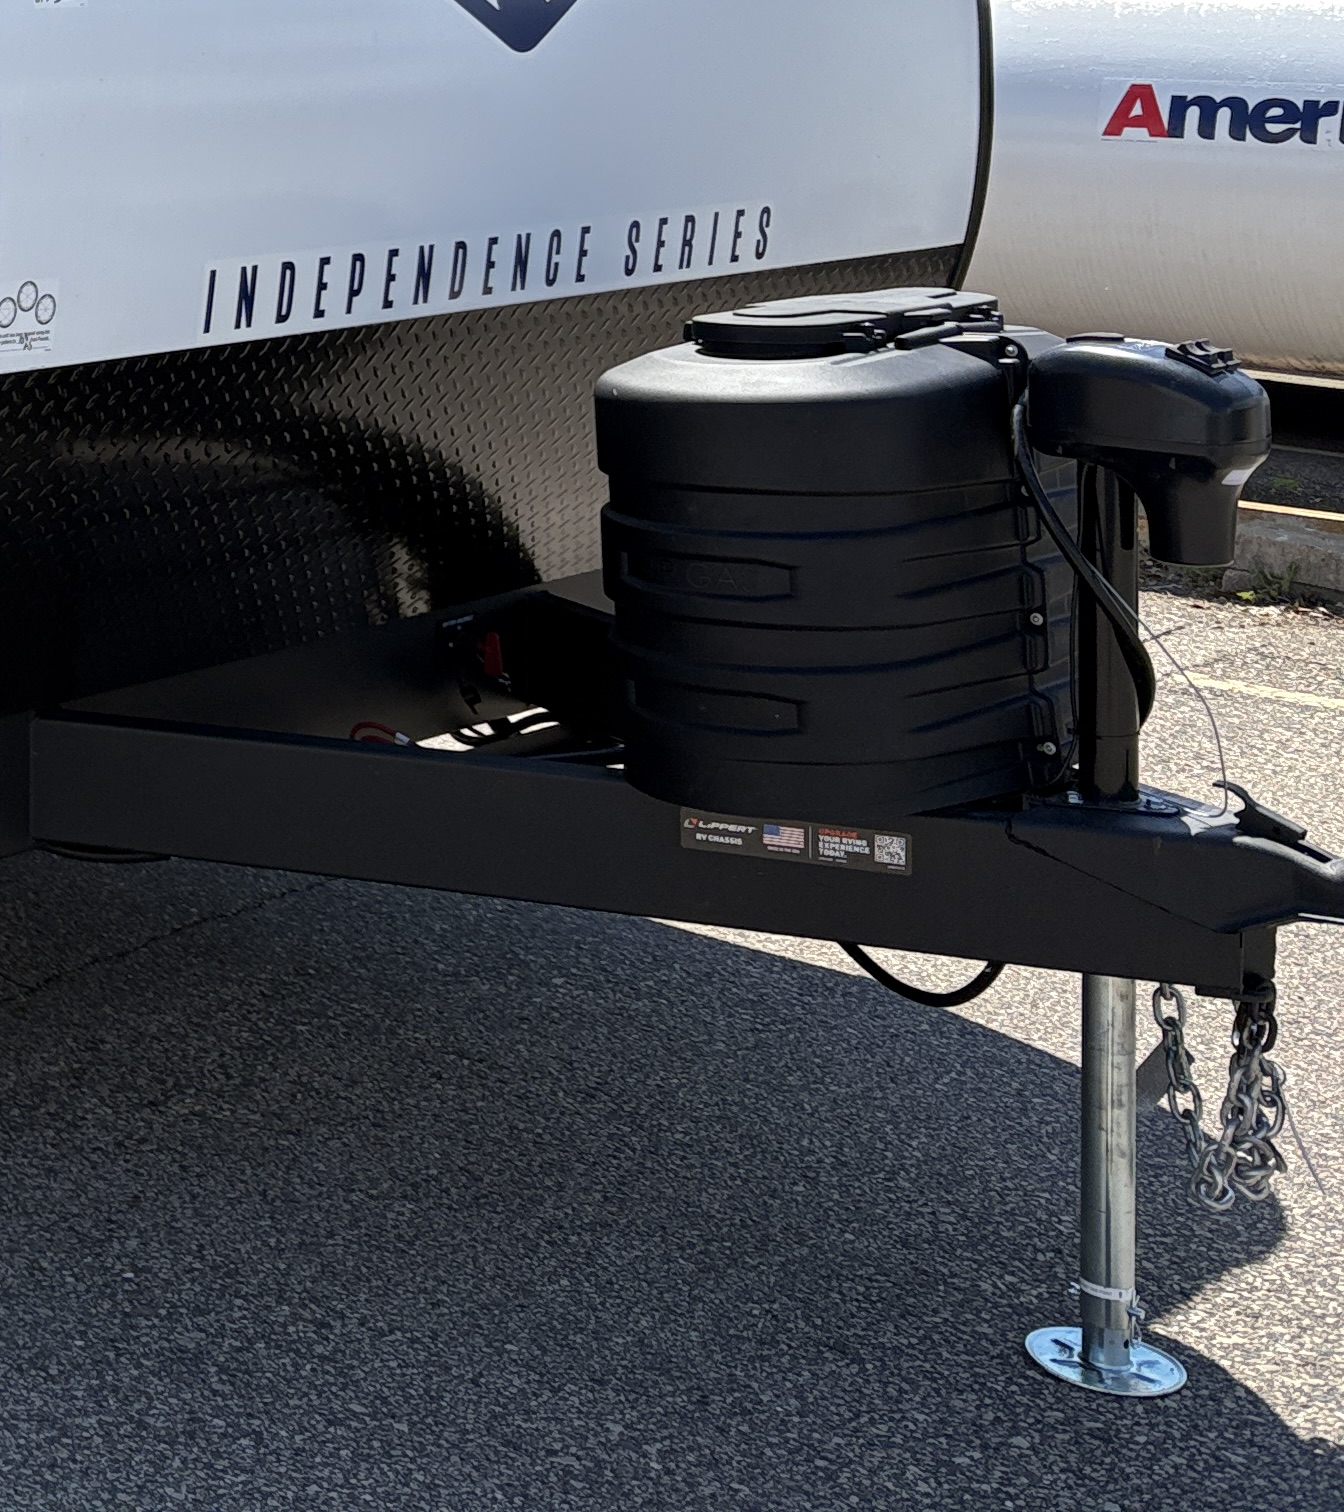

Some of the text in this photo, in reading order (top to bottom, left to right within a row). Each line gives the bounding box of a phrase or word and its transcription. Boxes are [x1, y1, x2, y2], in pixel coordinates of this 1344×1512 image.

[1102, 83, 1344, 145] Amer
[202, 204, 772, 334] INDEPENDENCE SERIES
[708, 834, 743, 846] CHASSIS
